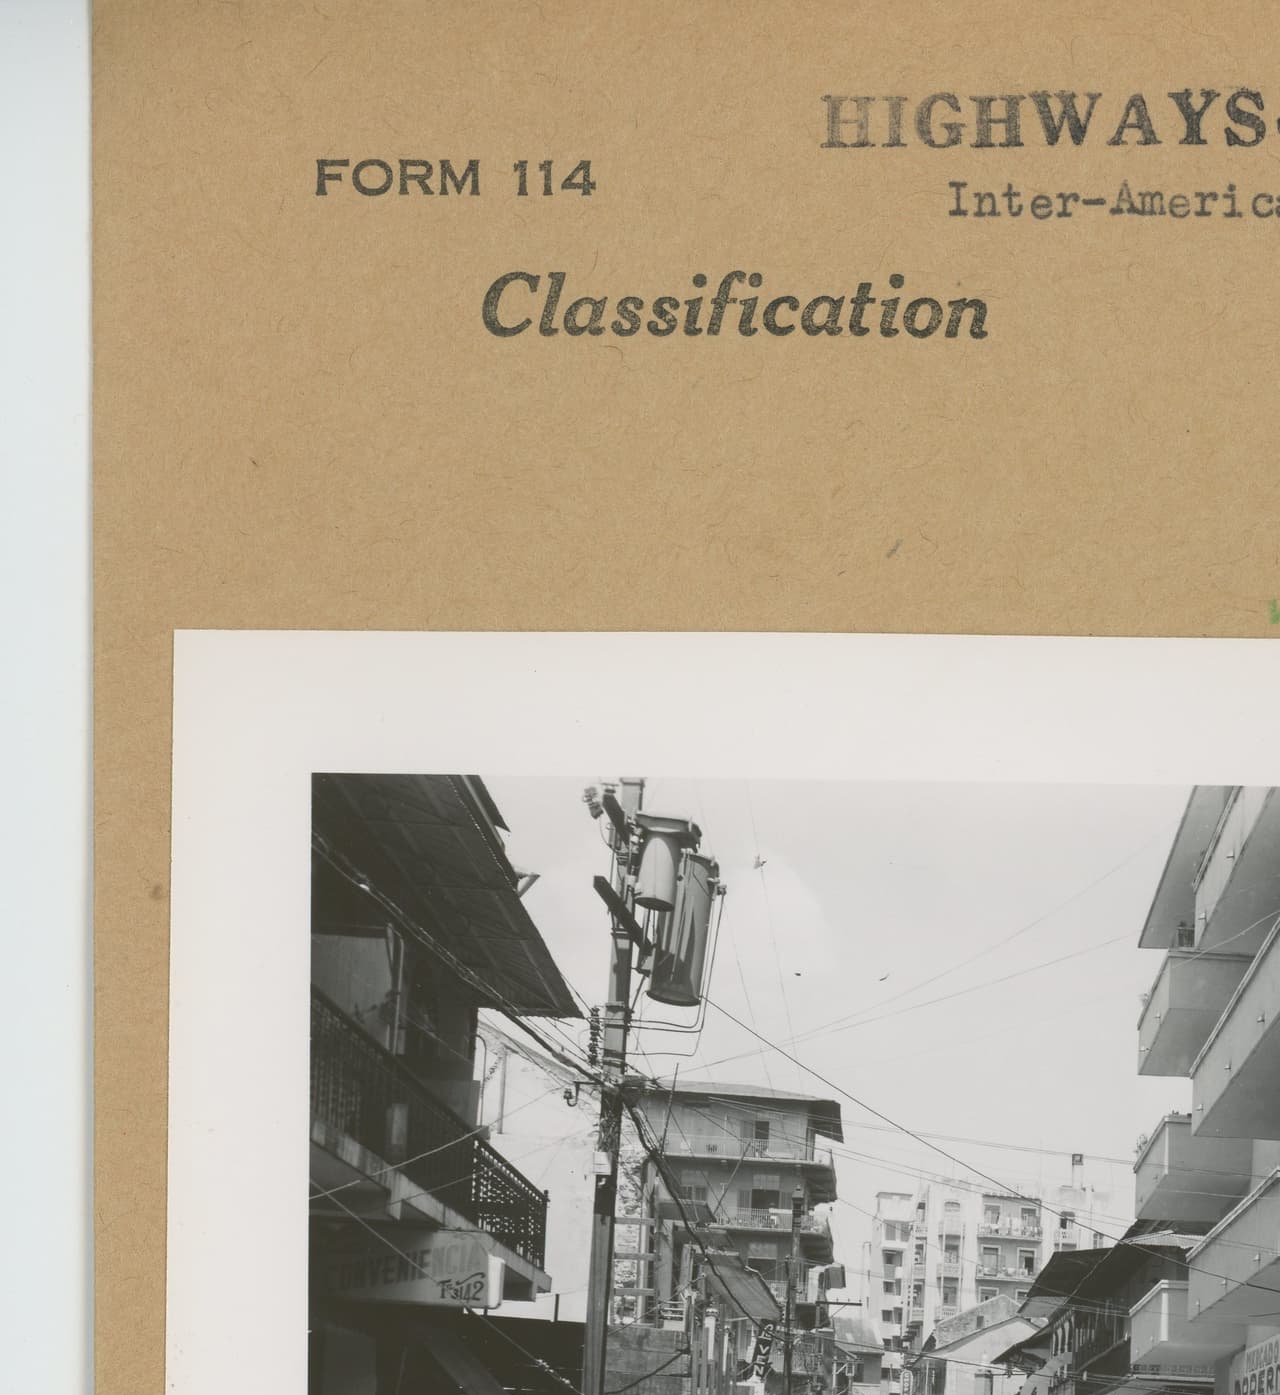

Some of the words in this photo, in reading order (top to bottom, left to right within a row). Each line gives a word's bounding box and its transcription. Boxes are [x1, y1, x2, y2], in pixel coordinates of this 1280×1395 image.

[315, 158, 481, 197] FORM
[513, 159, 597, 197] 114
[481, 269, 989, 340] Classification
